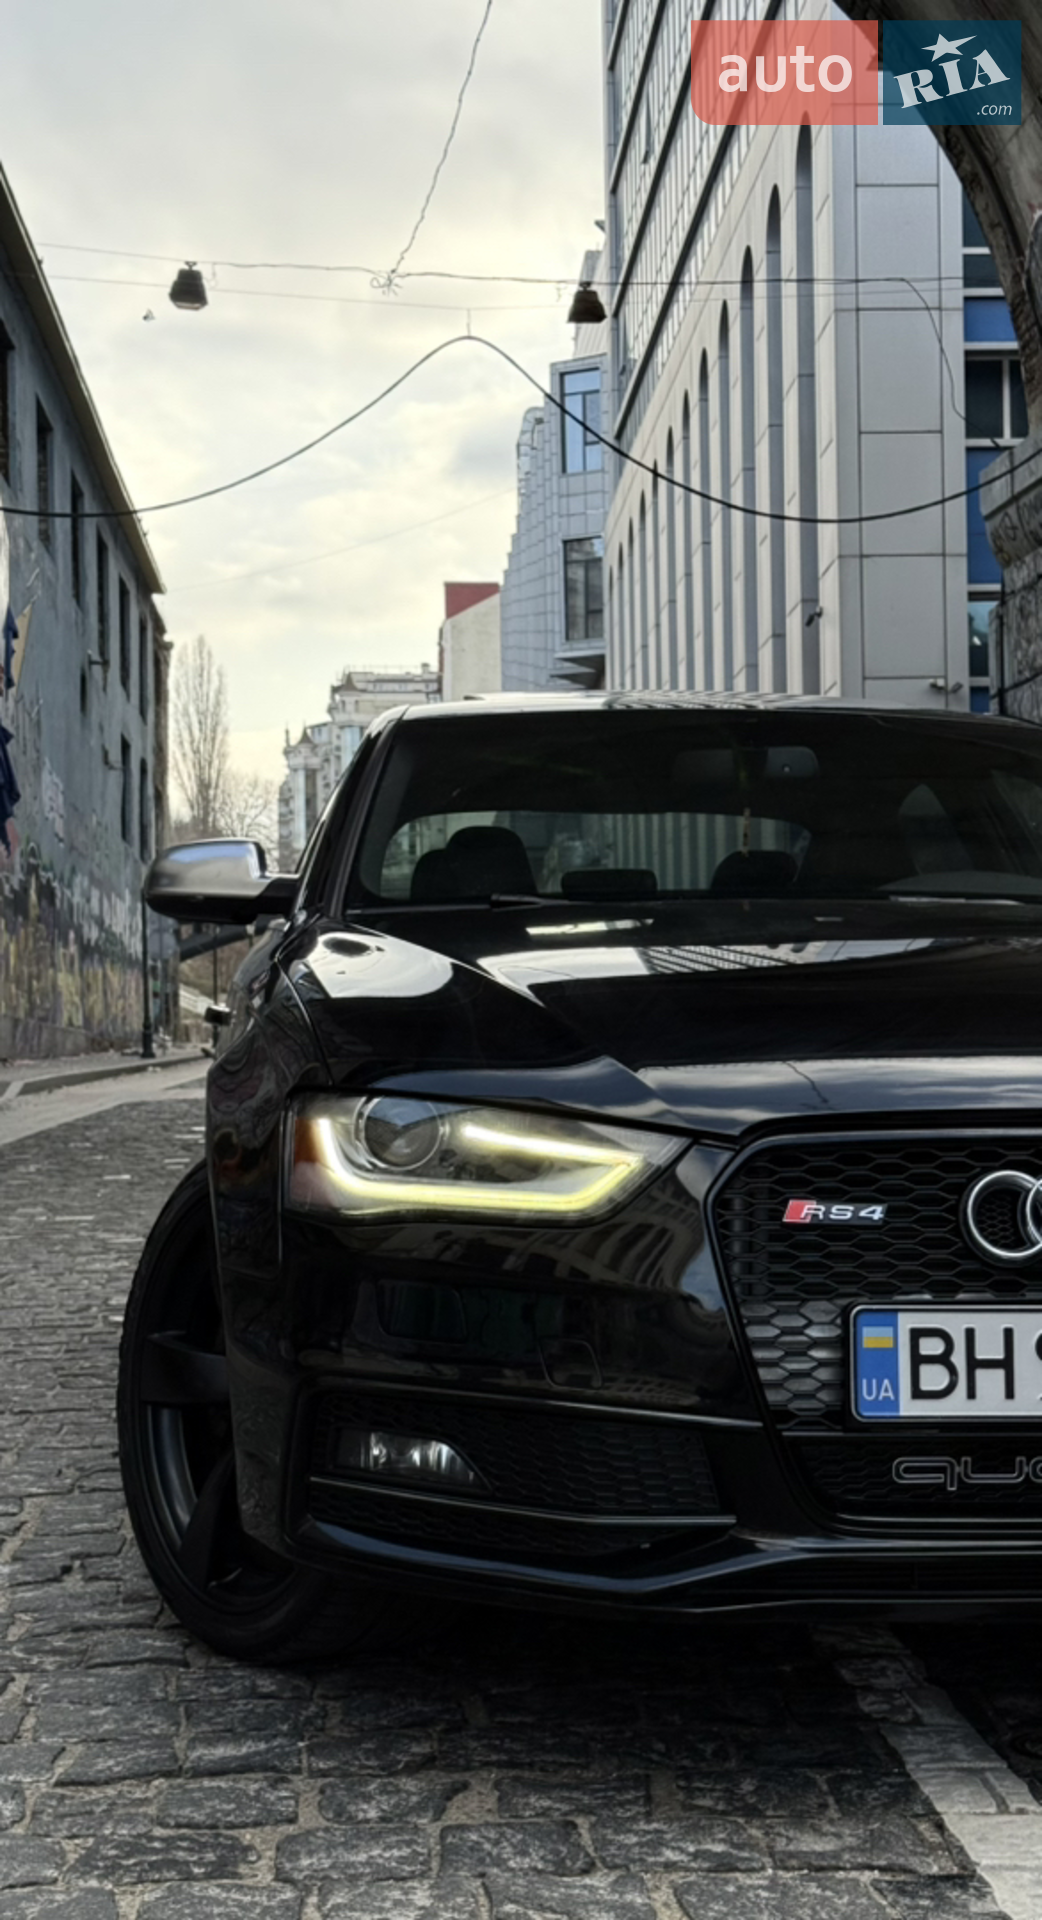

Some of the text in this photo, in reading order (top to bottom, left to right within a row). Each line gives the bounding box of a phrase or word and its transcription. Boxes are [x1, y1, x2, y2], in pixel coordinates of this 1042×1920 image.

[800, 1204, 884, 1220] RS4
[862, 1379, 894, 1400] UA
[892, 1456, 1042, 1490] qu
